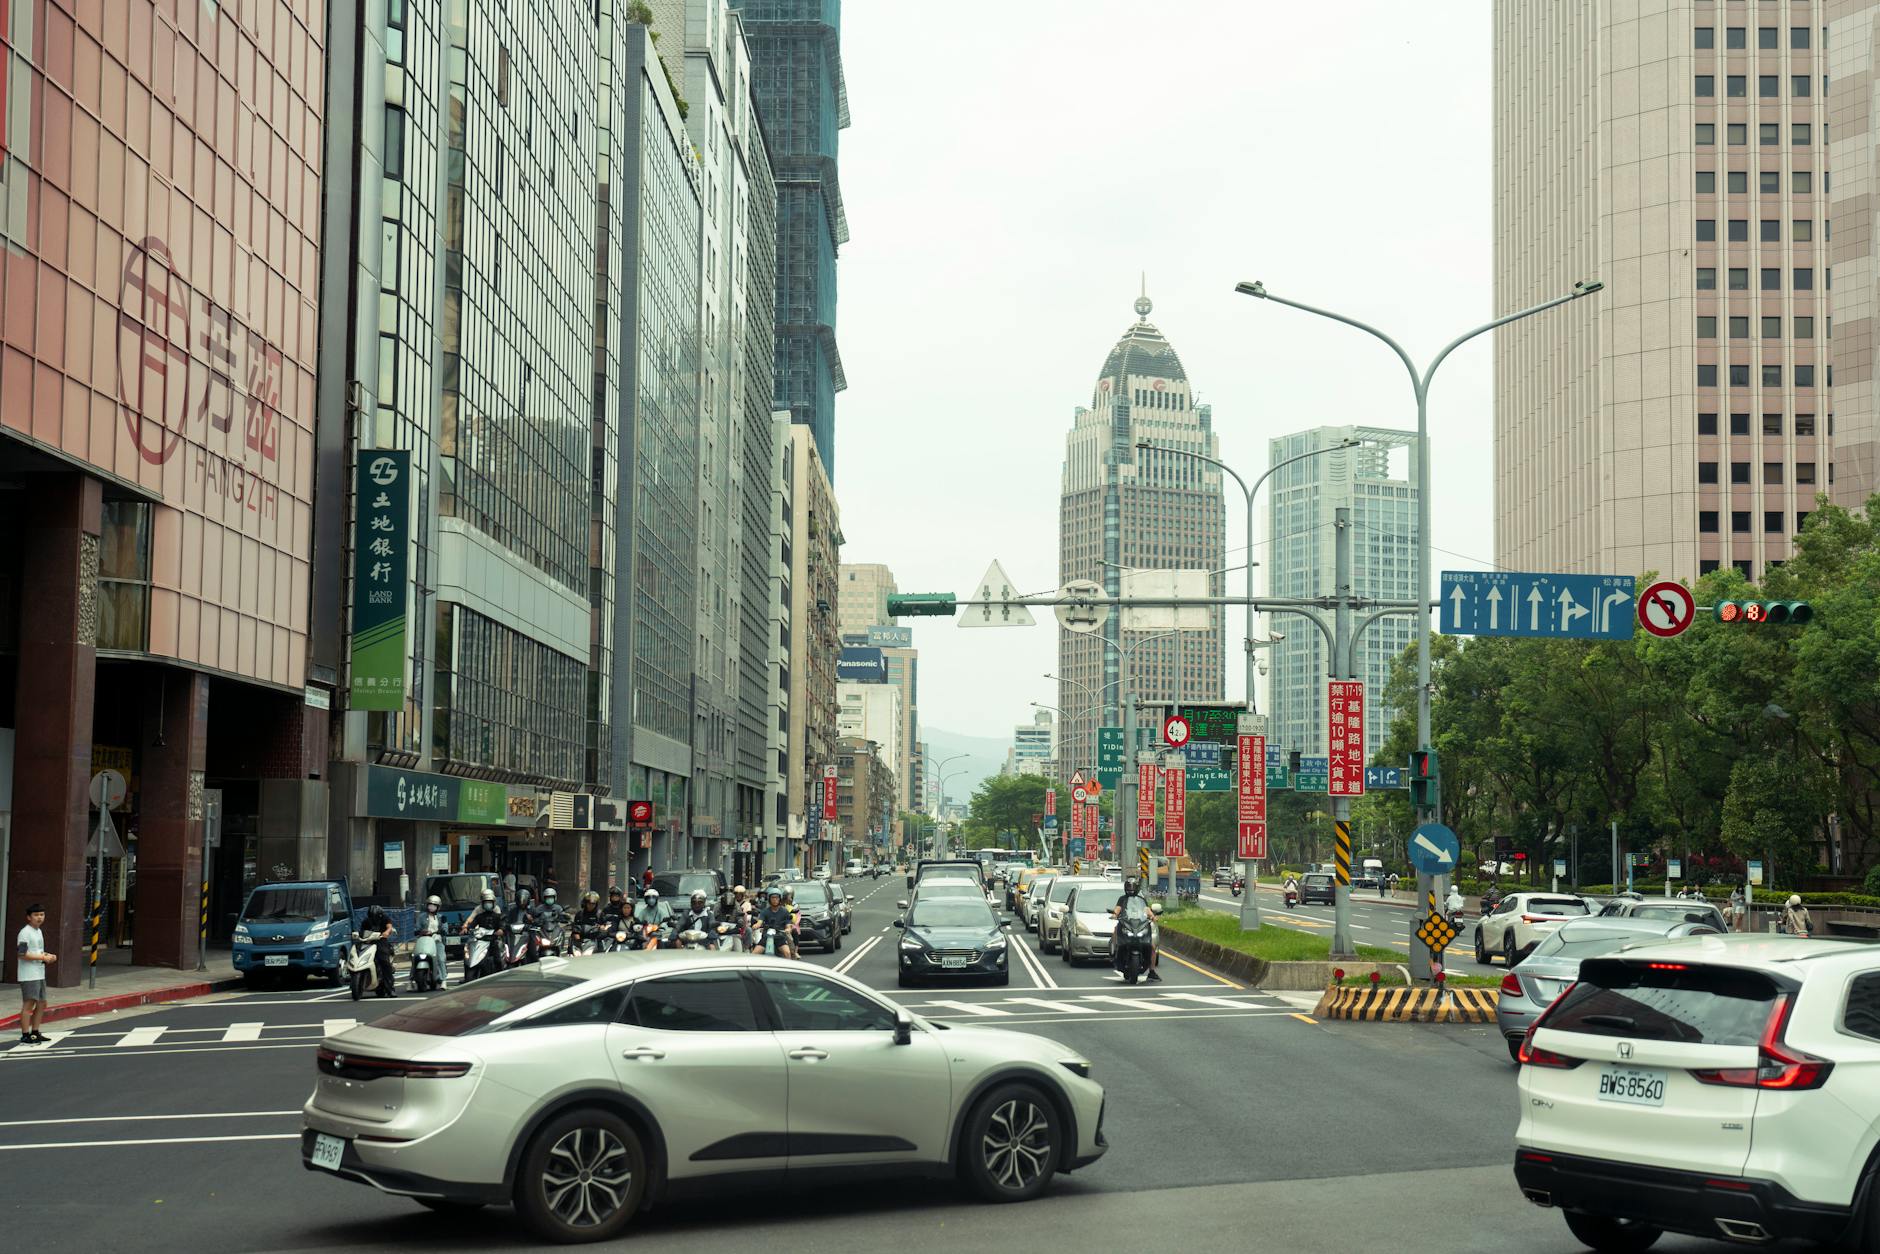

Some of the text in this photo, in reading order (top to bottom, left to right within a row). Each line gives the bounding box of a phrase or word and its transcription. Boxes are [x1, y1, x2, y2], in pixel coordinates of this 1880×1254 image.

[369, 492, 395, 584] 土地銀行
[1347, 700, 1361, 793] 基隆路地下道
[409, 784, 438, 809] 土地銀行
[1531, 1098, 1554, 1109] CR-V
